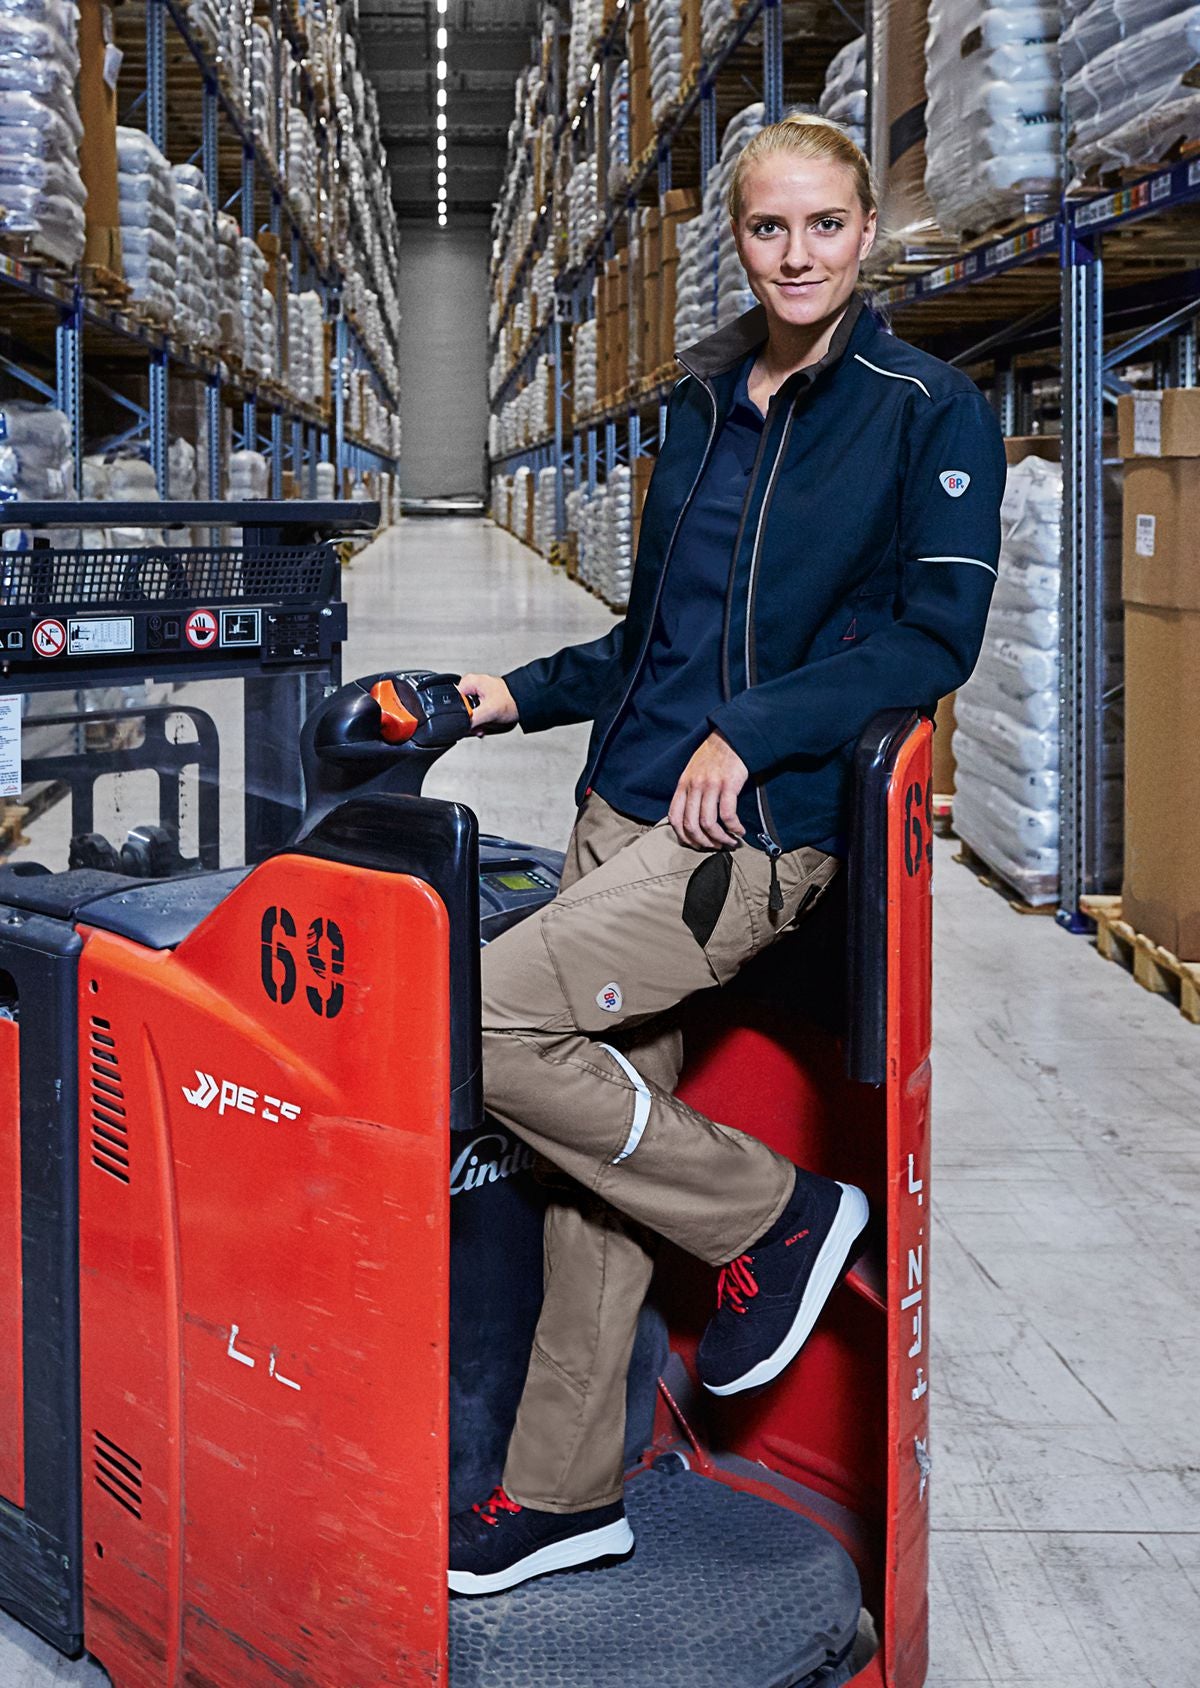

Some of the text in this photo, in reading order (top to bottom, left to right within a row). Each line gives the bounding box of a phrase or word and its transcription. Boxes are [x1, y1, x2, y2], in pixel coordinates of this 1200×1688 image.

[948, 477, 963, 489] BP
[261, 905, 345, 1019] 69
[604, 992, 616, 1006] BP
